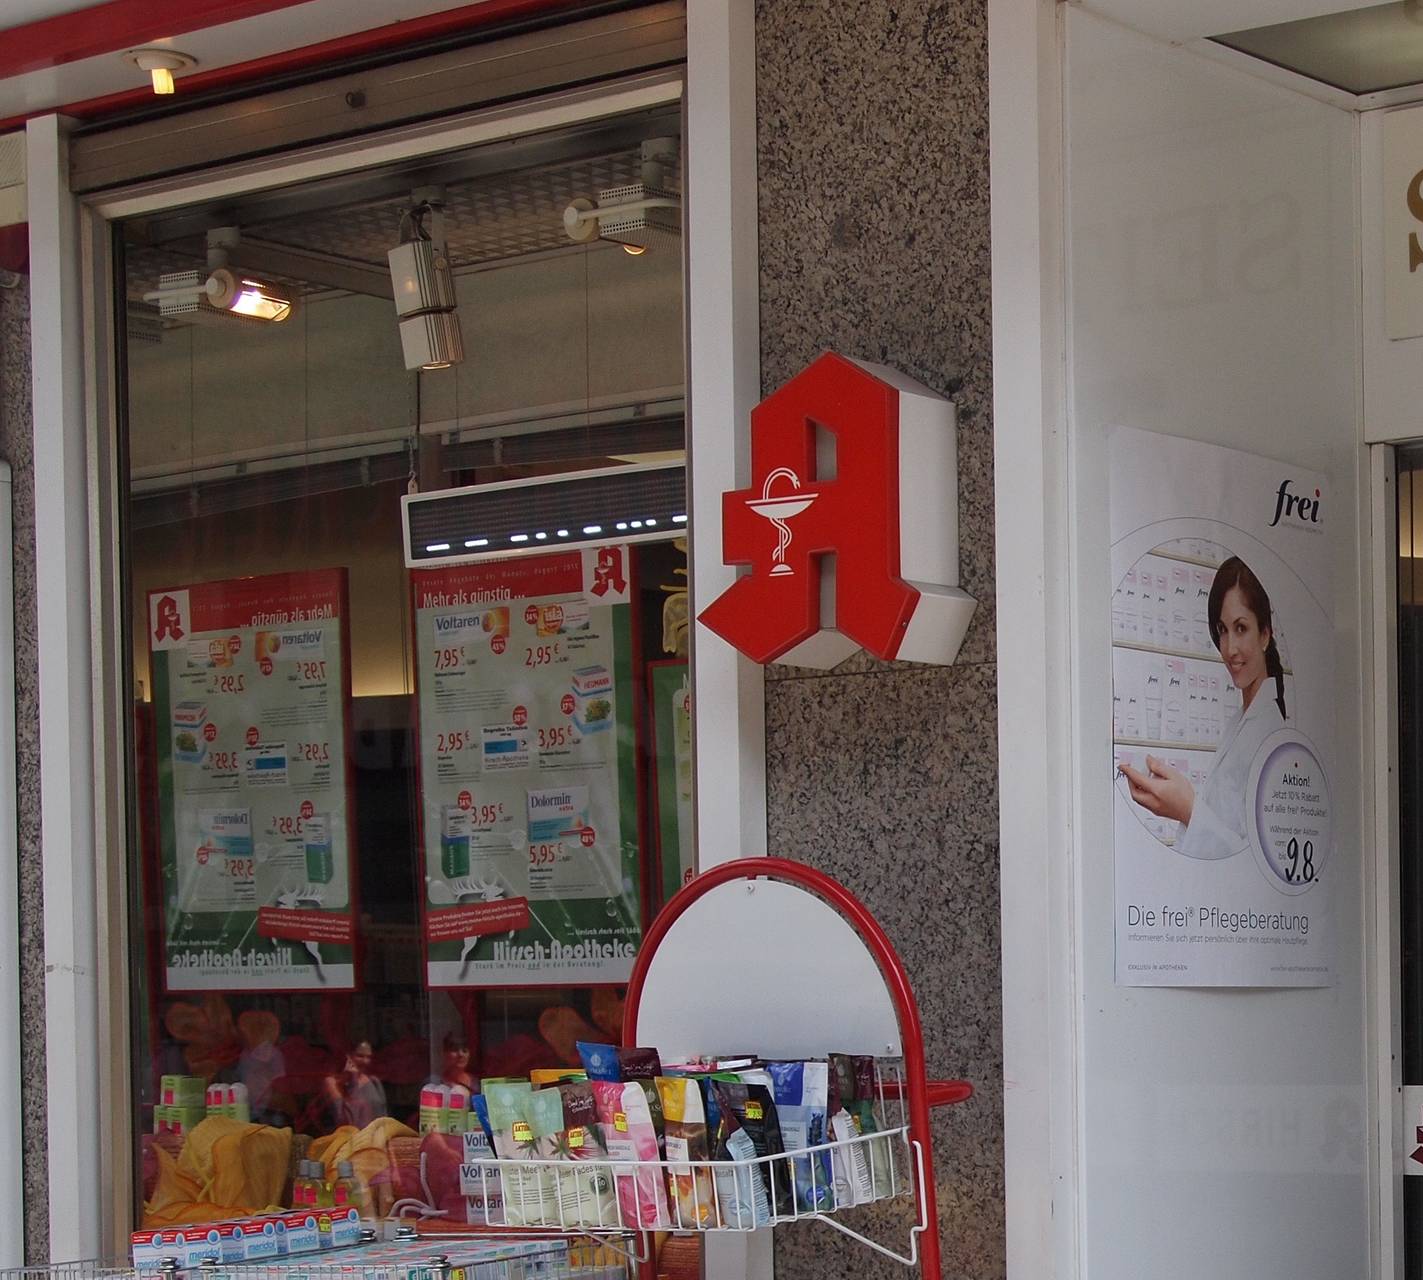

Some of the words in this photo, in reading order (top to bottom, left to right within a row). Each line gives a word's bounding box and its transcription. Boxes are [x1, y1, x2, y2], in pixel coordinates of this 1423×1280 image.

[1268, 479, 1320, 527] frei
[423, 592, 451, 608] Mehr
[453, 589, 469, 604] als
[436, 615, 480, 631] Voltaren
[434, 649, 458, 670] 7,95
[525, 647, 551, 669] 2,95
[437, 732, 463, 753] 2,95
[537, 728, 565, 750] 3,95
[1282, 774, 1310, 787] Aktion!
[530, 793, 571, 809] Dolormin
[1272, 790, 1287, 800] Jetzt
[471, 805, 496, 827] 3,95
[1275, 804, 1286, 813] alle
[529, 845, 555, 865] 5,95
[1128, 905, 1156, 926] Die
[1199, 907, 1309, 935] Pflegeberatung
[1128, 933, 1164, 941] Informieren
[1165, 934, 1174, 942] Sie
[1189, 935, 1203, 943] jetzt
[493, 938, 635, 961] Hirsch-Apotheke
[248, 1241, 276, 1253] meridol
[290, 1235, 317, 1247] meridol
[189, 1248, 220, 1261] meridol
